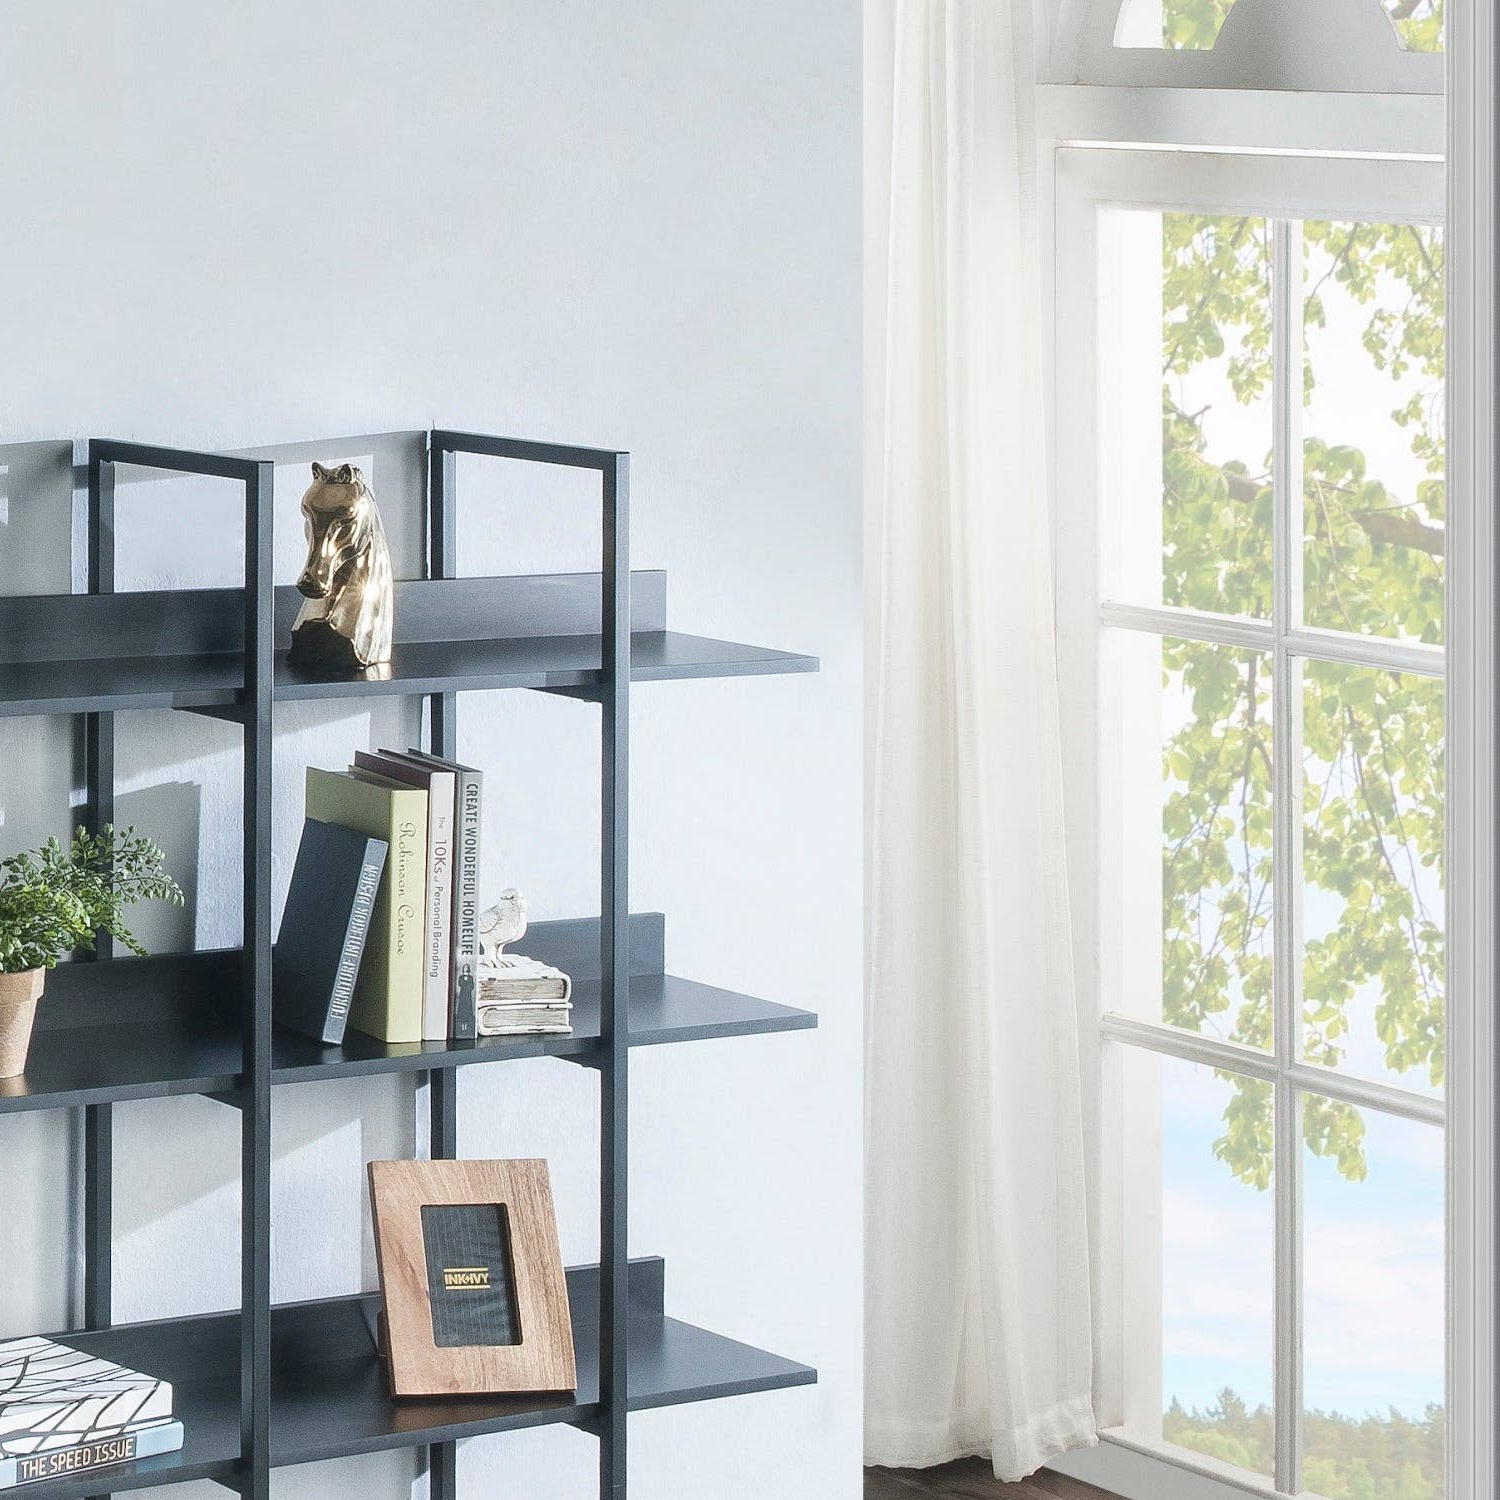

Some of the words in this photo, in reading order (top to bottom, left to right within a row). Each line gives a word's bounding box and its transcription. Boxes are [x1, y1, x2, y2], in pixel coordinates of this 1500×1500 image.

[465, 783, 478, 823] CREATE
[463, 827, 477, 896] WONDERFUL
[433, 886, 444, 930] Personal
[461, 900, 475, 956] HOMELIFE
[429, 926, 442, 978] Branding
[21, 1456, 48, 1479] THE
[50, 1447, 91, 1474] SPEED
[94, 1438, 134, 1463] ISSUE
